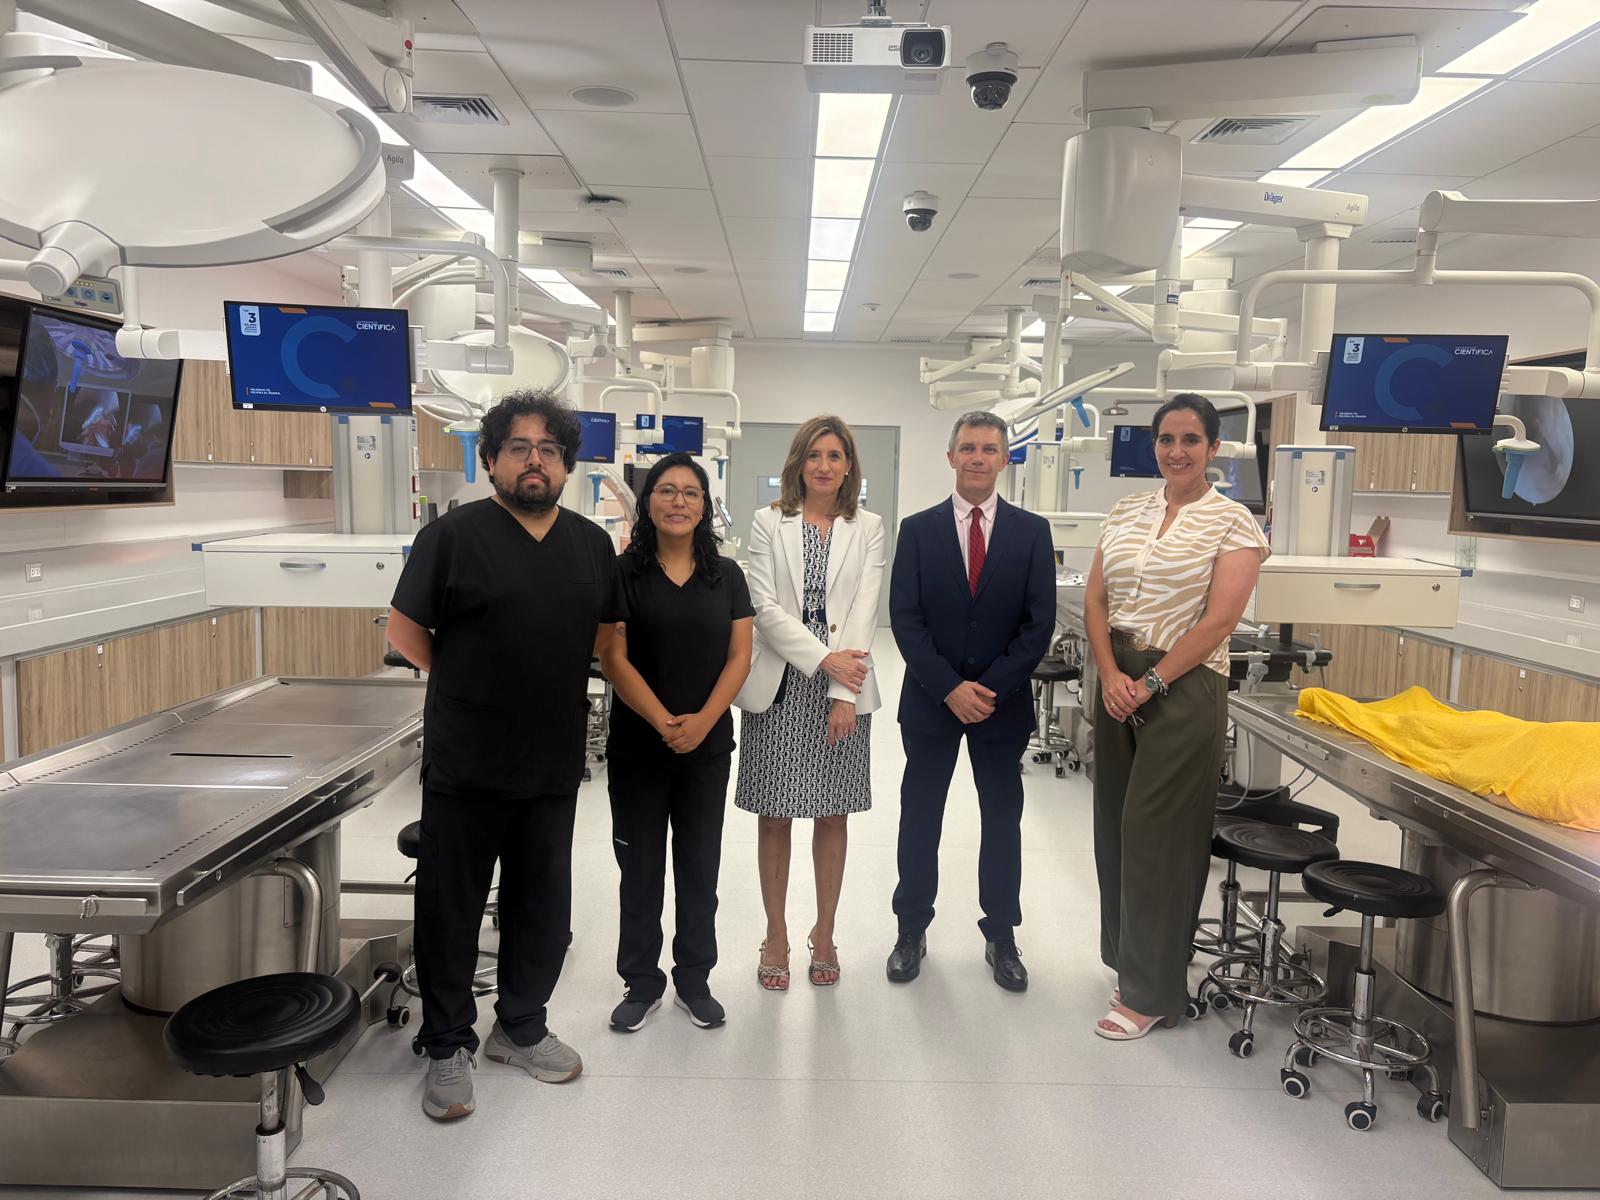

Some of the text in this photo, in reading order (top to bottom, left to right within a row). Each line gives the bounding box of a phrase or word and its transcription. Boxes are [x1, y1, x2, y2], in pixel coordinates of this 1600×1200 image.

[1264, 192, 1283, 204] Dräger
[248, 312, 257, 323] 3
[1352, 343, 1361, 352] 3
